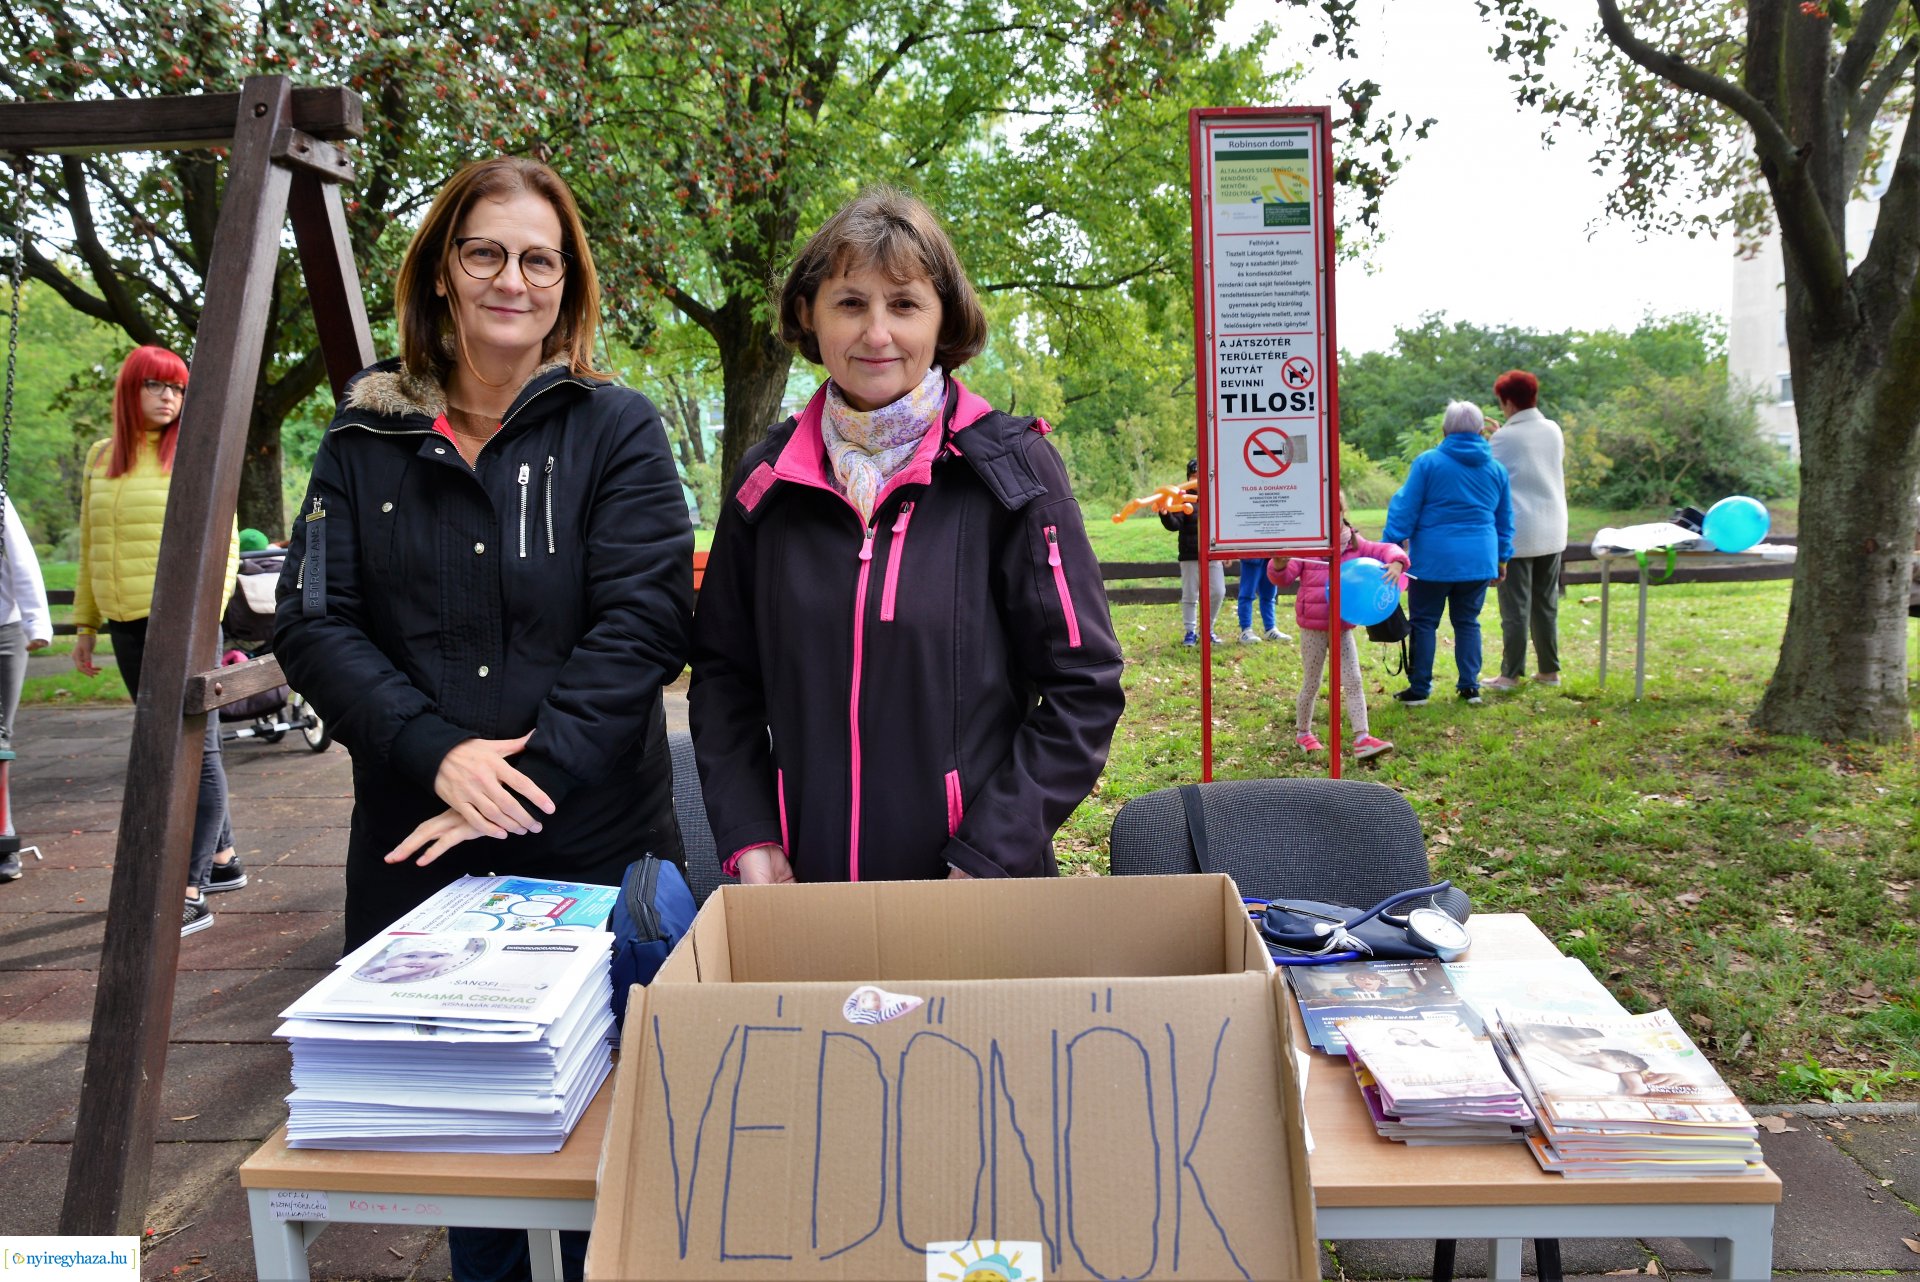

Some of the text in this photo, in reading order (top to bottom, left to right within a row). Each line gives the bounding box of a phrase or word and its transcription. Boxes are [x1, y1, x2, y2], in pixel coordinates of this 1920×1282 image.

[1229, 139, 1294, 148] Robinson domb
[1220, 337, 1291, 348] A JÁTSZÓTÉR
[1220, 352, 1288, 362] TERÜLETÉRE
[1220, 364, 1264, 374] KUTYÁT
[1221, 379, 1264, 388] BEVINNI
[1221, 392, 1315, 414] TILOS!
[452, 978, 499, 988] SANOFI
[390, 989, 538, 1005] KISMAMA CSOMAG
[653, 987, 1252, 1281] VÉDŐNŐK
